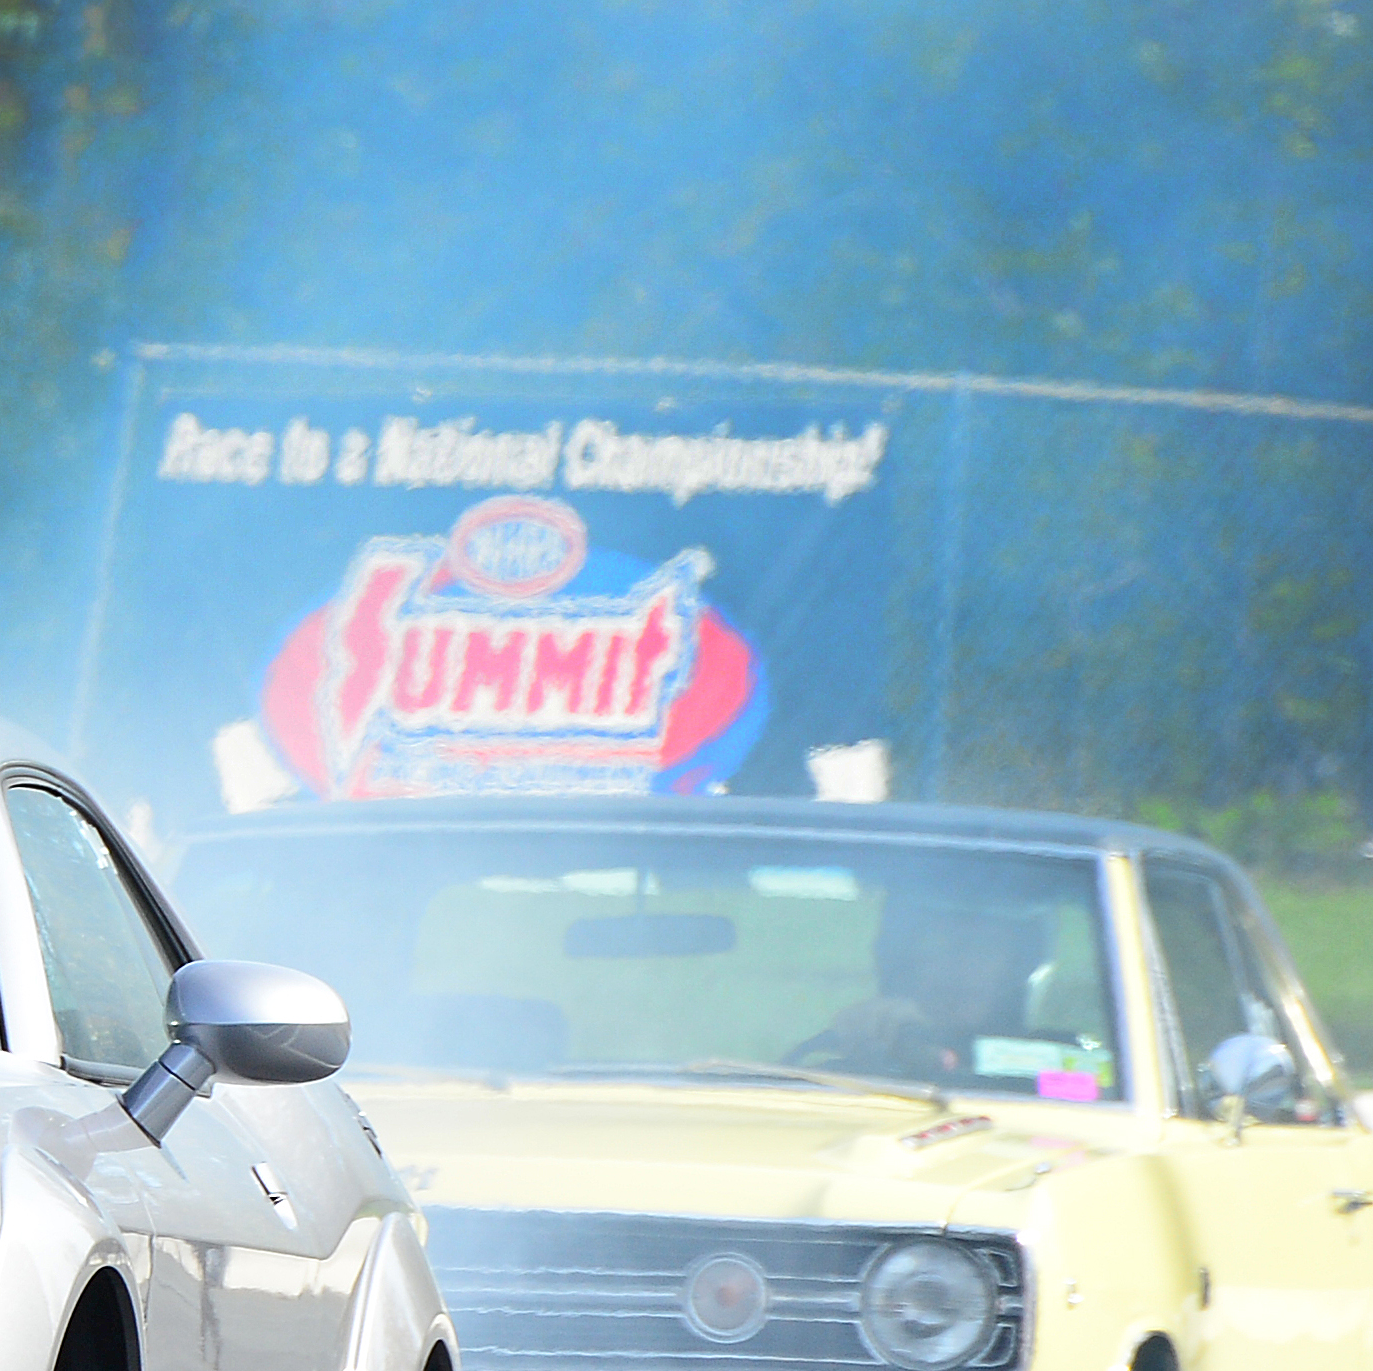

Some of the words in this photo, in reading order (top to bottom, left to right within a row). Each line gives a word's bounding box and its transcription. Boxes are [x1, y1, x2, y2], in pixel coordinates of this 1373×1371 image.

[158, 412, 273, 487] Race
[281, 414, 331, 485] to
[336, 428, 372, 485] a
[375, 415, 564, 490] National
[564, 419, 889, 507] Championship!
